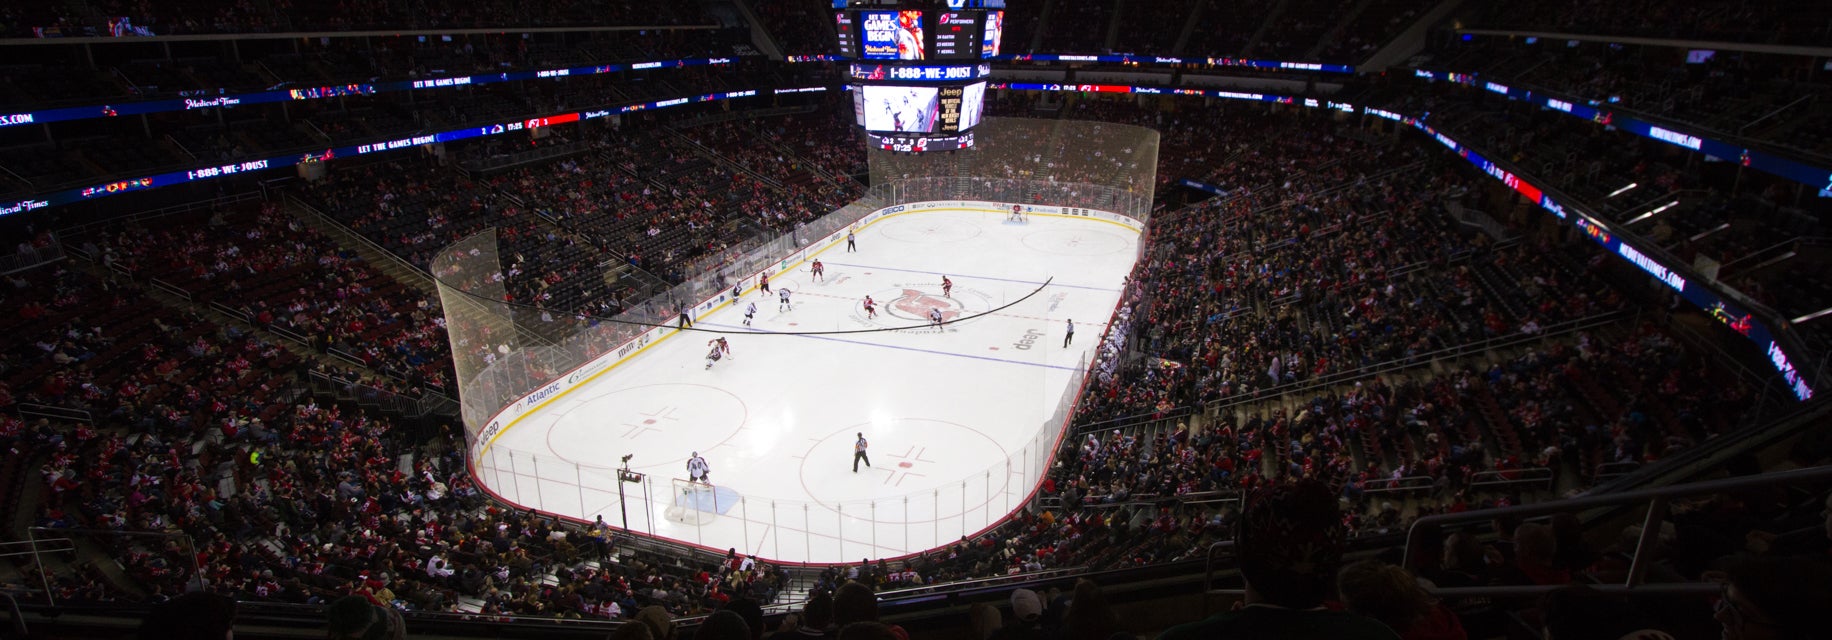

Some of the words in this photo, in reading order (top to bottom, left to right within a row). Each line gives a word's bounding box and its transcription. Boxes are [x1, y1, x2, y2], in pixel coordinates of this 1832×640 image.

[864, 19, 897, 31] GAMES
[867, 30, 895, 42] BEGIN
[890, 66, 971, 79] 1-888-WE-JOUST
[413, 81, 424, 89] LET
[424, 80, 435, 88] THE
[435, 78, 454, 87] GAMES
[940, 87, 962, 97] Jeep
[185, 96, 219, 110] Medieval
[219, 96, 241, 107] Times
[507, 122, 523, 131] 17:25
[357, 144, 371, 154] LET
[372, 142, 386, 151] THE
[387, 138, 412, 149] GAMES
[892, 144, 912, 152] 17:25
[187, 159, 269, 181] 1-888-WE-JOUST
[22, 199, 49, 211] Times
[881, 205, 905, 216] GEICO
[1012, 328, 1046, 351] Jeep
[527, 382, 561, 406] Atlantic
[480, 419, 500, 446] Jeep
[691, 461, 702, 470] 40
